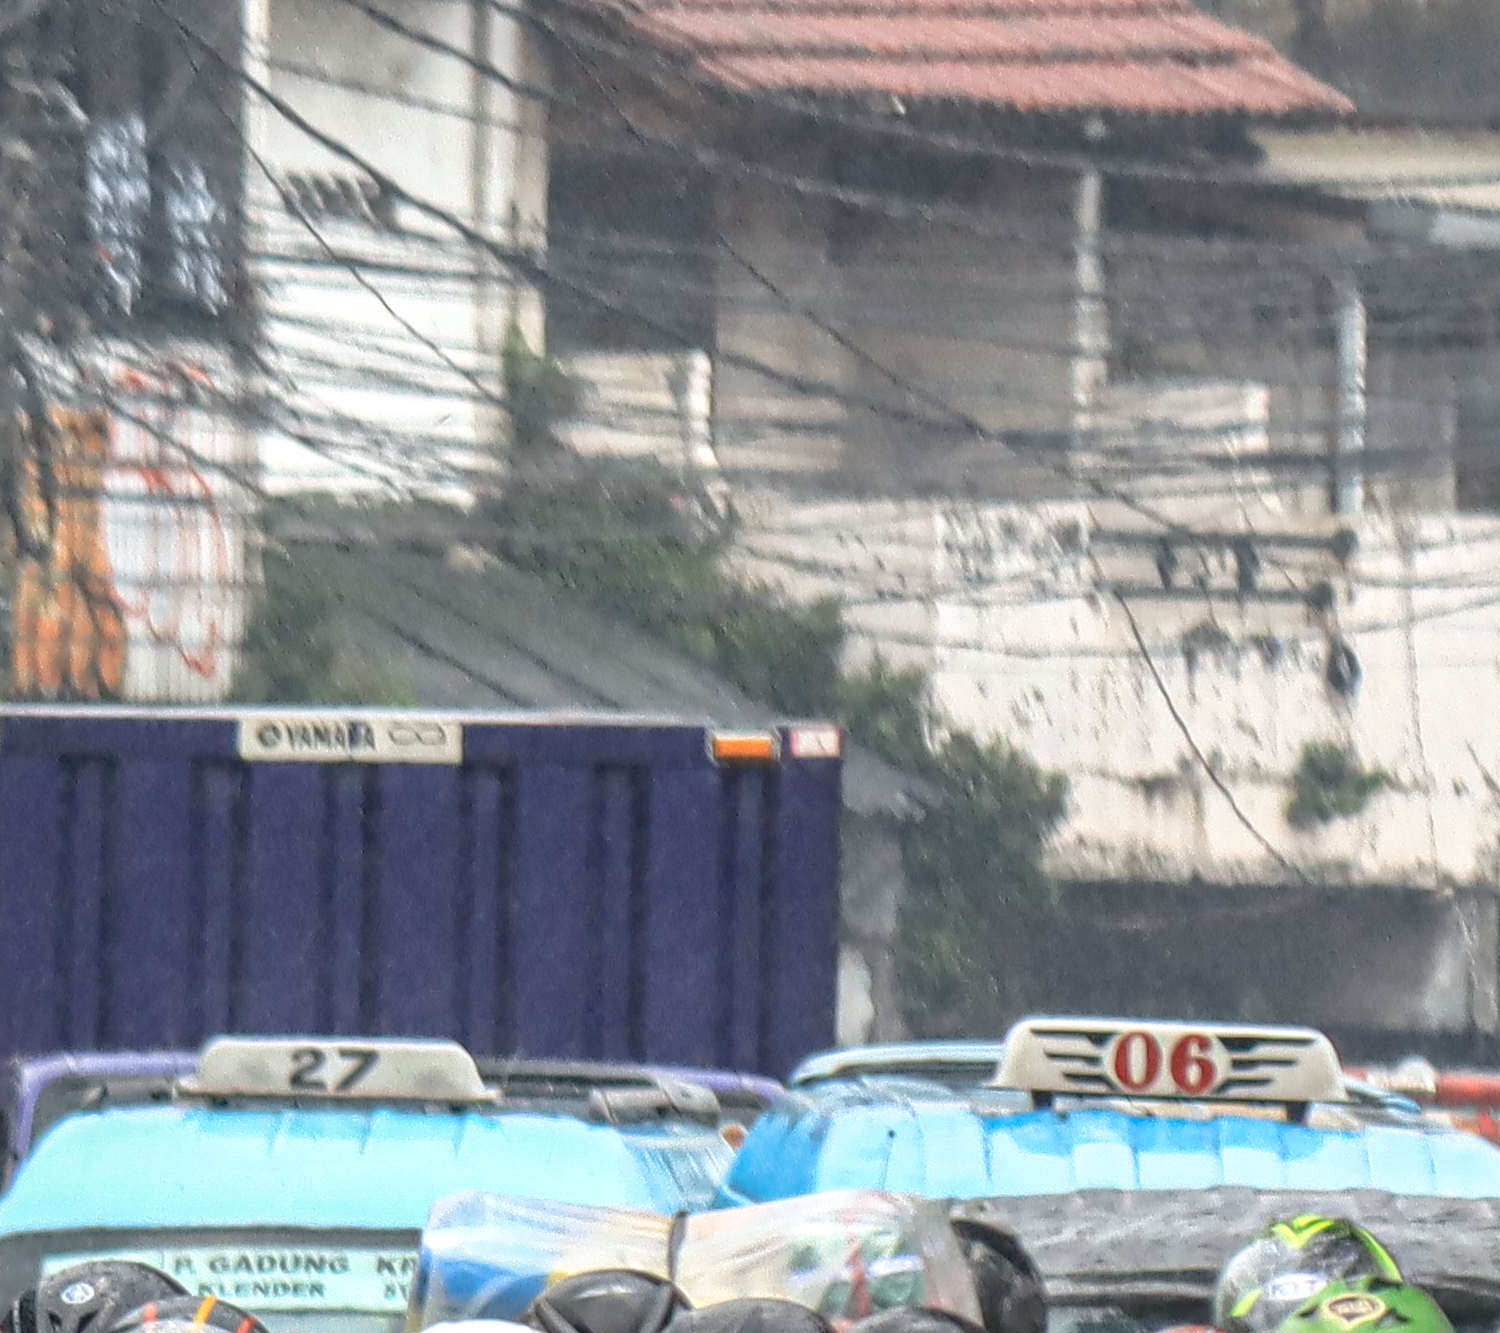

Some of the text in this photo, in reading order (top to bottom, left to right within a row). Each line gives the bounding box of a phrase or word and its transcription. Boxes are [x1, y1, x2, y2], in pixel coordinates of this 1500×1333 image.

[290, 1048, 380, 1091] 27
[1114, 1030, 1217, 1096] 06
[208, 1254, 350, 1276] GADUNG
[200, 1280, 325, 1298] KLENDER
